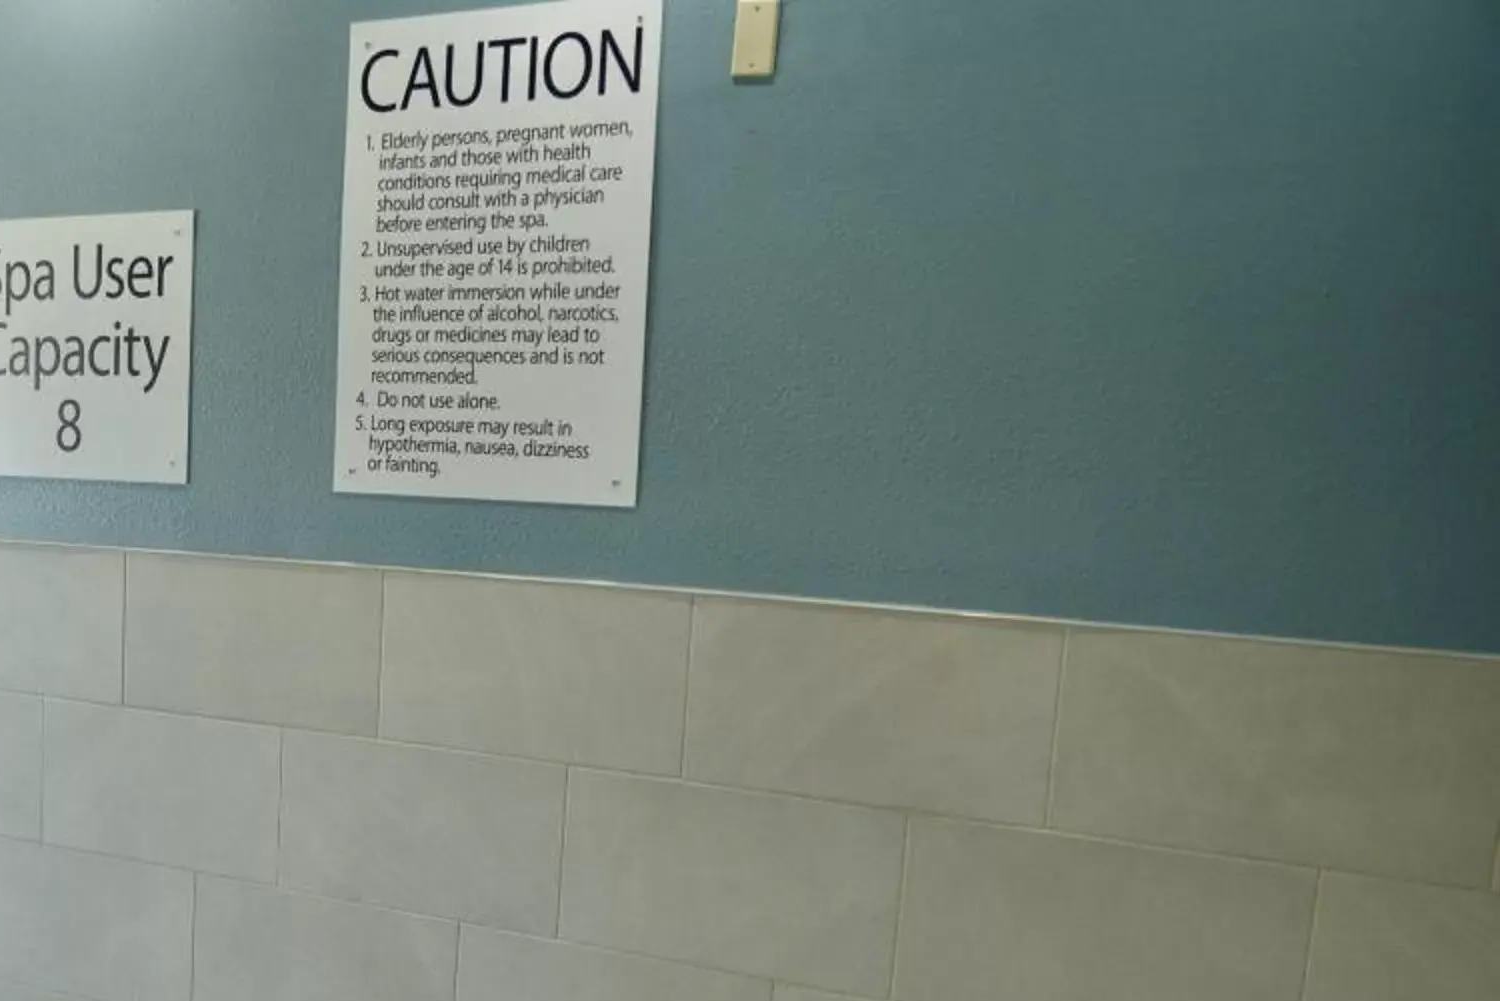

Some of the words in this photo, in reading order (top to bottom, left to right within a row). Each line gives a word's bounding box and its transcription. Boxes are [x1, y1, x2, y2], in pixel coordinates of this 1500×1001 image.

[361, 26, 643, 113] CAUTION
[381, 131, 427, 150] Elderly
[431, 131, 493, 151] persons,
[496, 124, 565, 147] pregnant
[569, 119, 633, 138] women,
[379, 154, 426, 170] infants
[430, 152, 457, 167] and
[460, 149, 501, 166] those
[506, 147, 539, 163] with
[543, 143, 591, 160] health
[377, 173, 451, 192] conditions
[455, 170, 521, 190] requiring
[526, 166, 585, 183] medical
[589, 166, 623, 181] care
[376, 195, 425, 212] should
[428, 192, 480, 210] consult
[484, 191, 517, 208] with
[521, 194, 530, 207] a
[533, 188, 604, 210] physician
[376, 216, 422, 233] before
[426, 214, 486, 235] entering
[490, 213, 515, 229] the
[519, 213, 548, 231] spa.
[361, 241, 373, 257] 2.
[377, 240, 474, 259] Unsupervised
[477, 241, 503, 255] use
[507, 239, 526, 257] by
[529, 236, 590, 252] children
[73, 243, 173, 298] User
[375, 260, 416, 278] under
[420, 260, 444, 276] the
[447, 262, 474, 281] age
[478, 259, 495, 275] of
[499, 259, 513, 274] 14
[517, 258, 528, 274] is
[531, 257, 615, 277] prohibited.
[359, 286, 371, 302] 3.
[375, 286, 401, 302] Hot
[404, 286, 444, 300] water
[448, 285, 525, 300] immersion
[529, 282, 570, 299] while
[574, 283, 620, 299] under
[373, 305, 396, 322] the
[400, 305, 465, 322] influence
[468, 305, 484, 321] of
[487, 305, 543, 322] alcohol,
[372, 327, 412, 345] drugs
[416, 329, 432, 343] or
[435, 326, 507, 343] medicines
[511, 329, 543, 347] may
[547, 326, 579, 343] lead
[583, 328, 600, 343] to
[371, 349, 420, 363] serious
[423, 349, 526, 368] consequences
[529, 348, 559, 365] and
[562, 349, 574, 365] is
[578, 350, 605, 365] not
[371, 367, 478, 385] recommended.
[355, 392, 369, 406] 4.
[377, 391, 398, 407] Do
[402, 393, 425, 408] not
[429, 394, 453, 408] use
[457, 392, 500, 410] alone.
[56, 399, 82, 452] 8
[355, 416, 367, 430] 5.
[371, 416, 405, 433] Long
[409, 418, 475, 438] exposure
[477, 419, 510, 439] may
[513, 420, 554, 435] result
[557, 420, 572, 437] in
[369, 435, 461, 455] hypothermia,
[465, 442, 519, 458] nausea,
[523, 440, 590, 459] dizziness
[367, 458, 382, 471] or
[385, 457, 440, 478] fainting.
